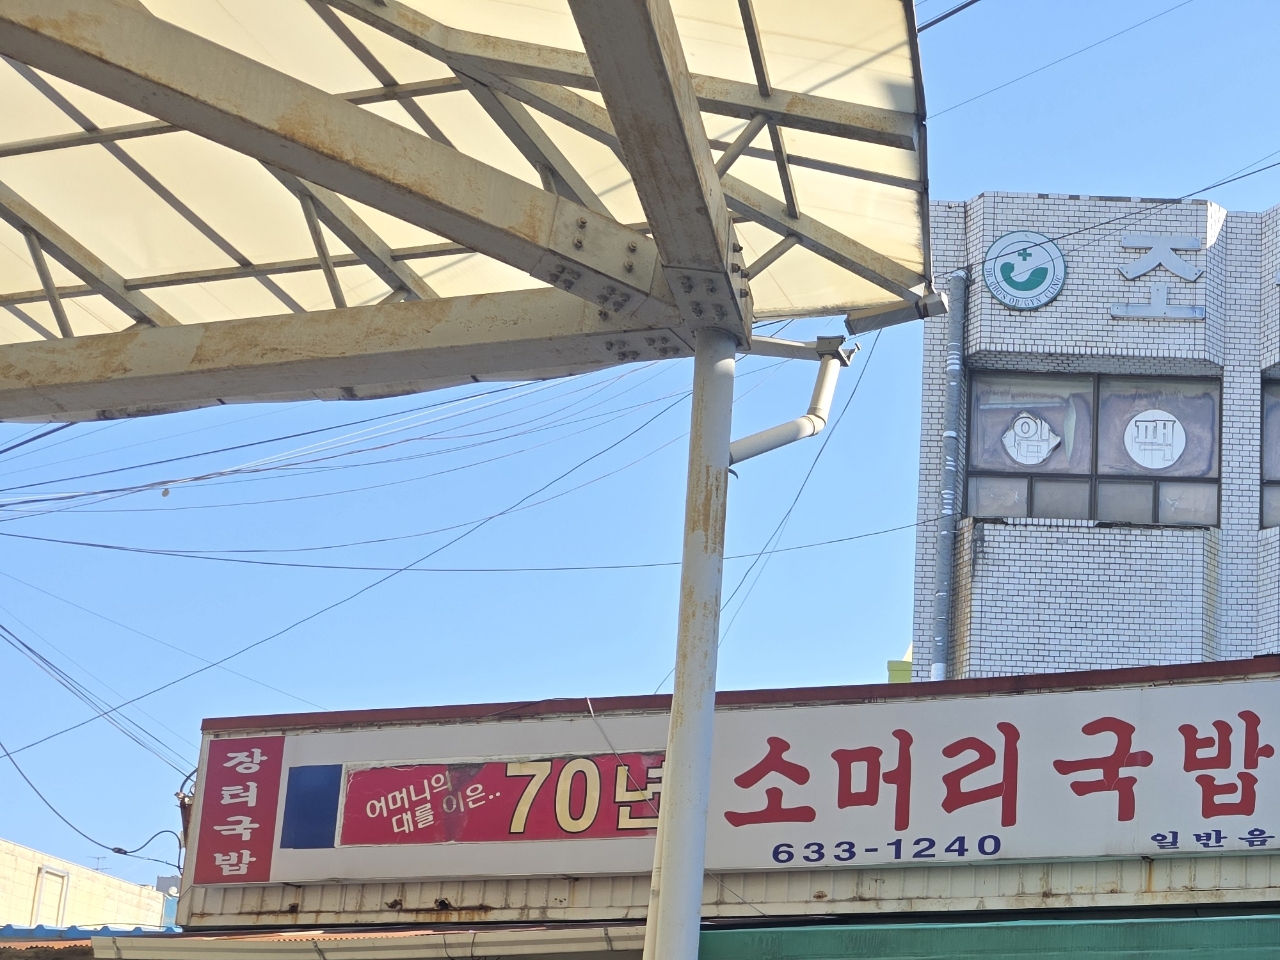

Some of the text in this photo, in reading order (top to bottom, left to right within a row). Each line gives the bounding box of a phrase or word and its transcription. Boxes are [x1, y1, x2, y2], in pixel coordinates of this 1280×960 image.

[1044, 274, 1063, 299] CLINIC
[365, 771, 453, 820] 어머니의
[213, 748, 268, 876] 장터국밥
[391, 806, 435, 834] 대를
[772, 834, 1002, 864] 633-1240
